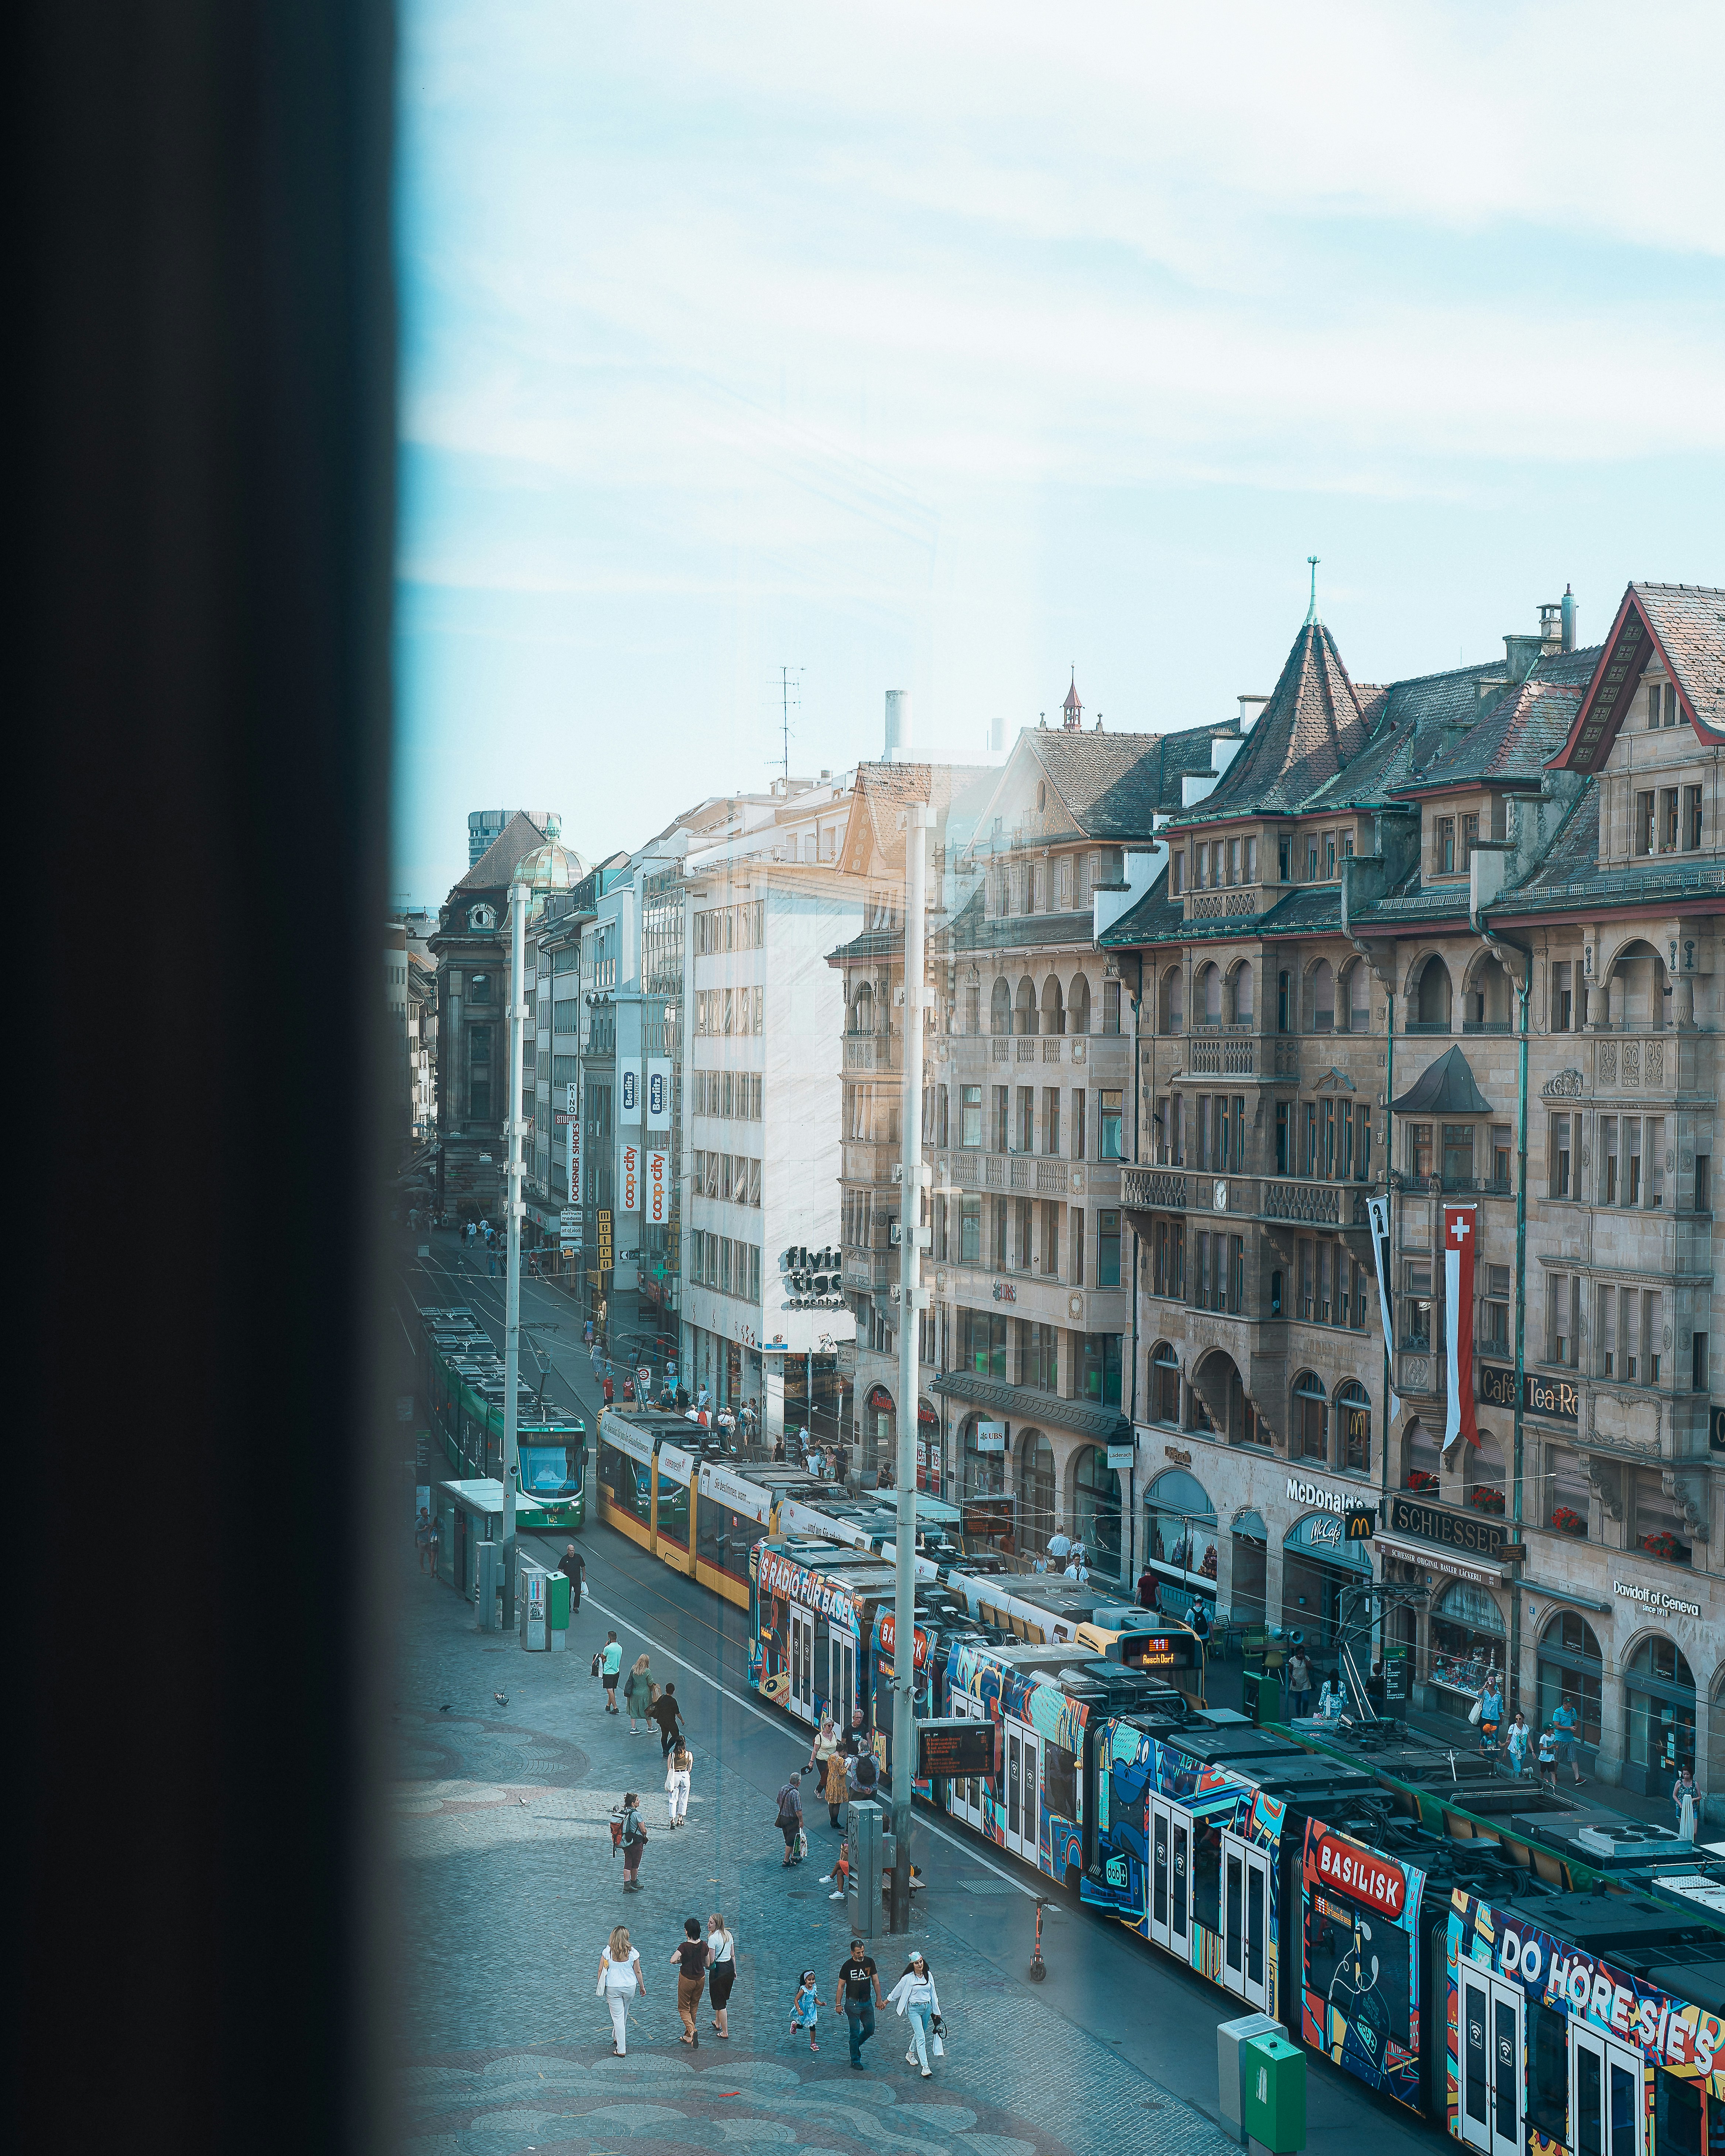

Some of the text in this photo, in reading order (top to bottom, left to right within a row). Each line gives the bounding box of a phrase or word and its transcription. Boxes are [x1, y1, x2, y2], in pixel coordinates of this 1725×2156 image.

[625, 1075, 633, 1106] Berlitz
[652, 1078, 661, 1110] Berlitz
[557, 1115, 575, 1123] STUDIO
[624, 1146, 637, 1208] coop city
[651, 1154, 665, 1220] coop city
[600, 1212, 609, 1268] metro
[1000, 1284, 1015, 1301] UBS
[872, 1391, 892, 1410] Bata
[1484, 1370, 1515, 1403] Café
[665, 1458, 681, 1472] careanesth
[1165, 1446, 1190, 1463] Läderach
[720, 1480, 737, 1499] bestimmen,
[816, 1527, 822, 1536] wo
[1311, 1519, 1341, 1547] McCafé
[1399, 1505, 1500, 1554] SCHIESSER
[1391, 1549, 1482, 1582] SCHIESSER ORIGINAL BASLER LÄCKERLI
[768, 1562, 800, 1597] RADIO
[800, 1576, 822, 1610] FÜR
[822, 1587, 856, 1627] BASEL
[1613, 1580, 1699, 1616] Davidoff of Geneva
[1642, 1603, 1668, 1617] since 1911
[1153, 1639, 1165, 1650] 11
[1160, 1653, 1174, 1664] Dorf
[1321, 1845, 1399, 1907] BASILISK
[850, 1967, 871, 1978] EA7
[1363, 1997, 1380, 2029] BASILISK
[1367, 1994, 1379, 2016] RADIO
[1501, 1929, 1541, 1982] DO
[1548, 1952, 1633, 2033] HÖRE
[1638, 1999, 1715, 2075] SIE'S
